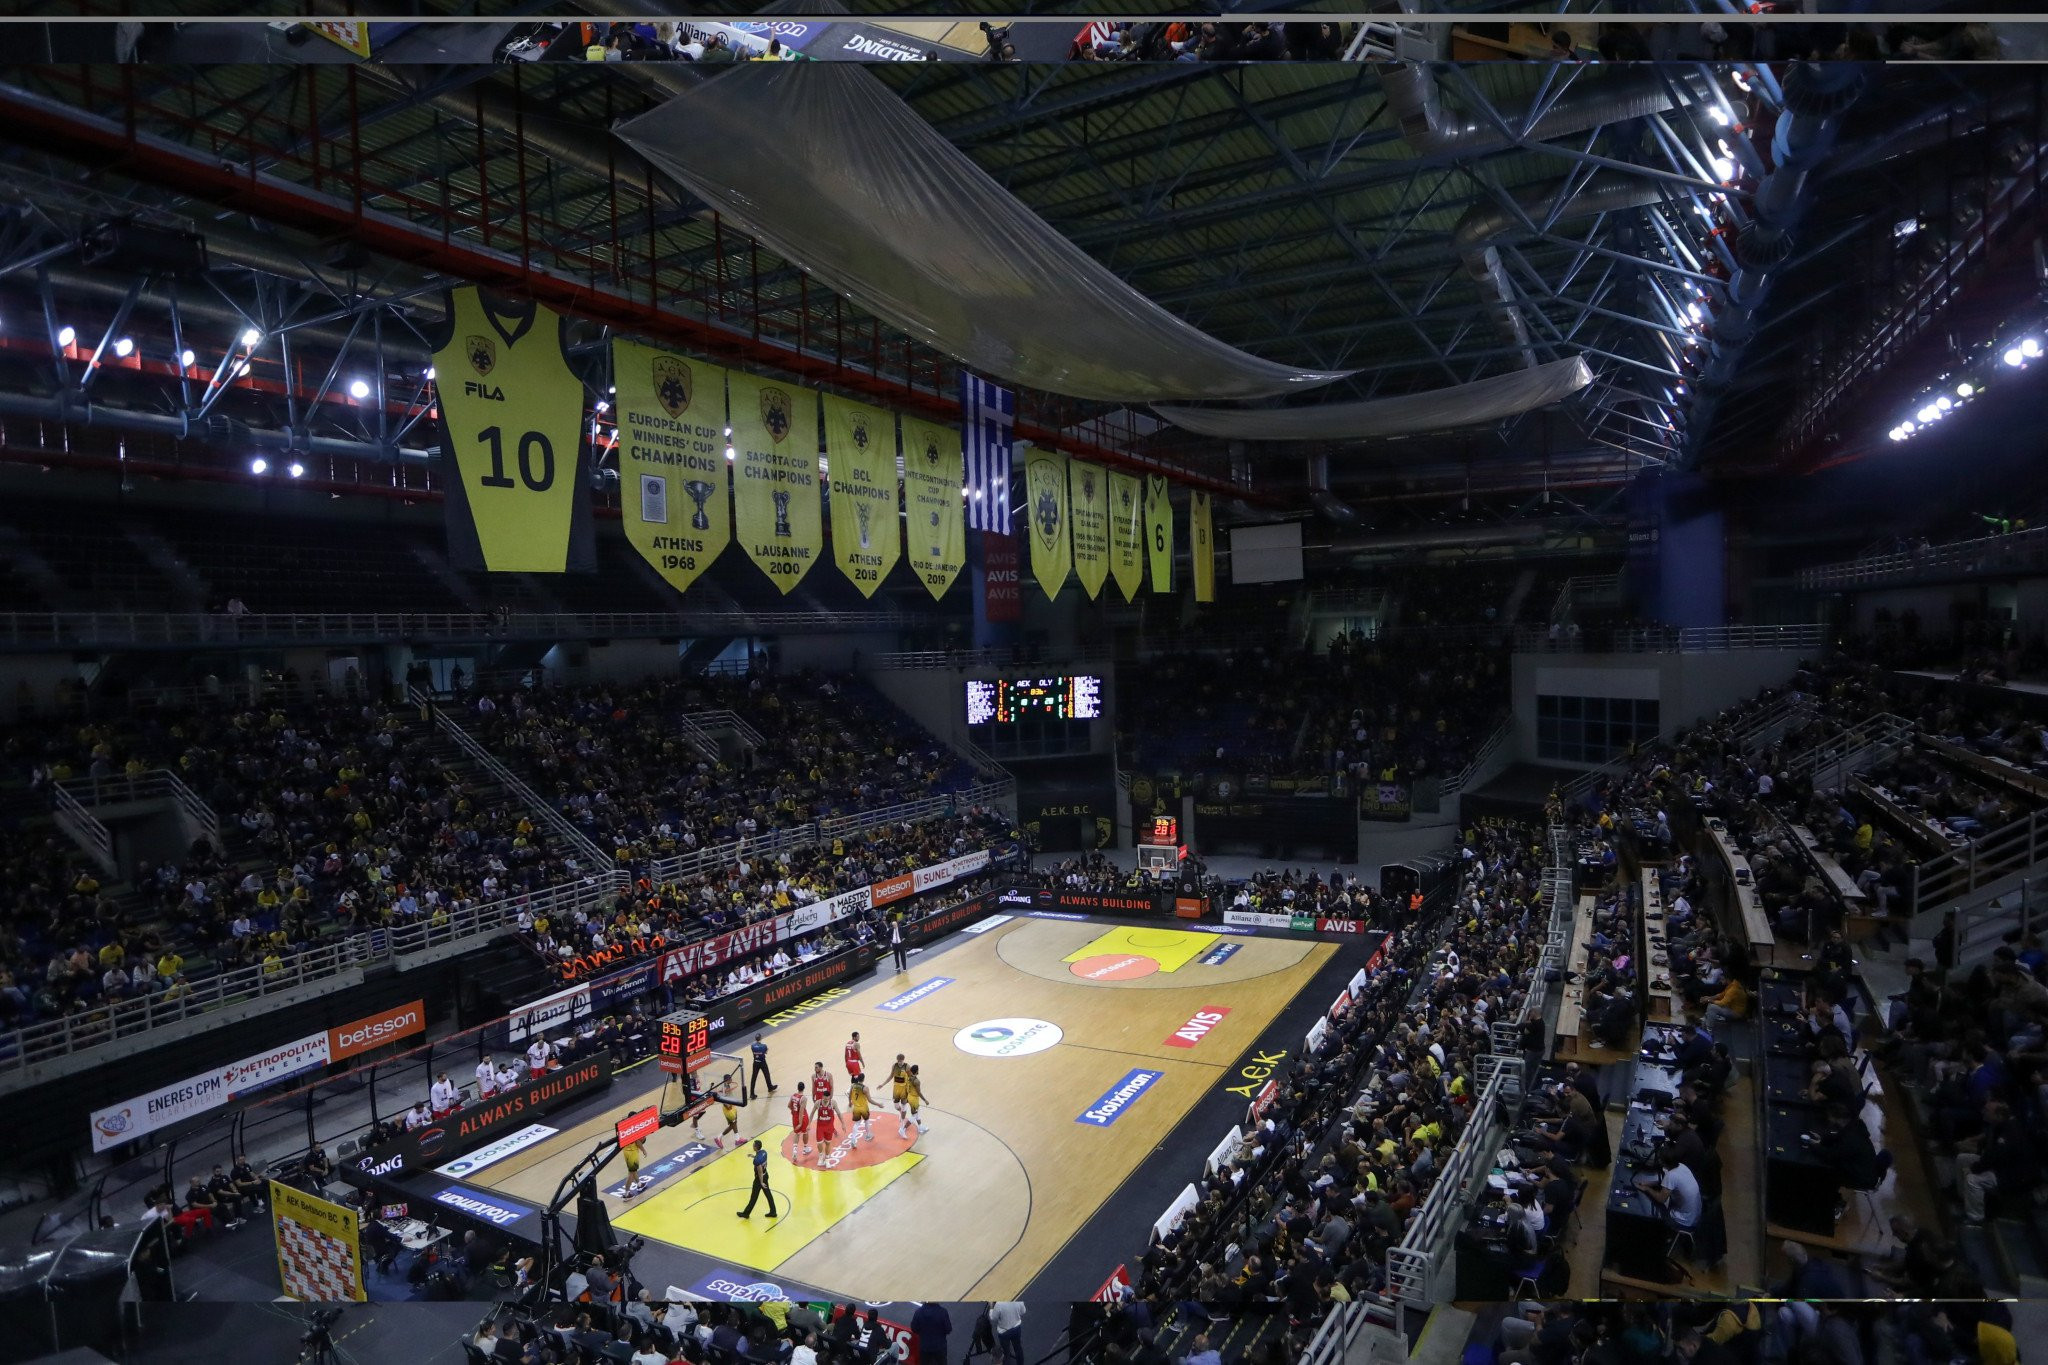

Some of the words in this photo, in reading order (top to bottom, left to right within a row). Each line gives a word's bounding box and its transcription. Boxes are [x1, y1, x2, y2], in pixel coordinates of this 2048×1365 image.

[465, 381, 505, 402] FILA
[628, 411, 692, 437] EUROPEAN
[695, 428, 717, 440] CUP
[632, 428, 690, 449] WINNERS'
[692, 438, 714, 455] CUP
[477, 425, 555, 492] 10
[630, 446, 716, 473] CHAMPIONS
[746, 451, 790, 469] SAPORTA
[791, 458, 809, 469] CUP
[744, 467, 812, 487] CHAMPIONS
[853, 469, 872, 483] BCL
[833, 481, 890, 501] CHAMPIONS
[928, 486, 940, 495] CUP
[917, 494, 951, 508] CHAMPIONS
[652, 535, 704, 553] ATHENS
[1156, 524, 1164, 552] 6
[754, 544, 810, 559] LAUSANNE
[849, 554, 882, 567] ATHENS
[661, 556, 696, 572] 1968
[770, 562, 800, 575] 2000
[913, 561, 924, 570] RIO
[925, 562, 933, 570] DE
[855, 569, 877, 581] 2018
[927, 574, 946, 585] 2019
[987, 570, 1018, 582] AVIS
[987, 588, 1019, 600] AVIS
[1038, 679, 1053, 687] OLY
[1041, 807, 1069, 816] A.E.K.
[1073, 805, 1091, 814] B.C.
[1154, 826, 1168, 835] 28
[923, 867, 952, 884] SUNEL
[837, 889, 870, 908] MAESTRO
[876, 881, 912, 898] betsson
[999, 895, 1031, 904] SPALDING
[1060, 896, 1098, 906] ALWAYS
[1102, 899, 1151, 909] BUILDING
[923, 915, 950, 933] ALWAYS
[951, 902, 982, 922] BUILDING
[1324, 920, 1356, 933] AVIS
[662, 942, 717, 981] AVIS
[724, 922, 774, 959] AVIS
[1085, 957, 1138, 979] betsson
[765, 982, 802, 1005] ALWAYS
[805, 960, 846, 987] BUILDING
[763, 988, 851, 1028] ATHENS
[339, 1012, 416, 1048] betsson
[662, 1022, 681, 1035] 8:36
[688, 1018, 708, 1034] 8:36
[1175, 1011, 1222, 1042] AVIS
[661, 1034, 681, 1054] 28
[686, 1030, 707, 1054] 28
[996, 1022, 1048, 1055] COSMOTE
[239, 1036, 326, 1074] METROPOLITAN
[661, 1060, 681, 1069] betsson
[687, 1054, 709, 1068] betsson
[240, 1048, 327, 1083] GENERAL
[147, 1085, 194, 1114] ENERES
[196, 1076, 221, 1096] CPM
[460, 1097, 524, 1136] ALWAYS
[530, 1065, 599, 1105] BUILDING
[1086, 1072, 1151, 1123] Stoiximan
[149, 1105, 183, 1124] SOLAR
[619, 1116, 656, 1138] betsson
[474, 1127, 547, 1161] COSMOTE
[672, 1143, 706, 1163] PAY
[287, 1195, 301, 1208] AEK
[328, 1212, 338, 1223] BC
[437, 1192, 521, 1223] Stoiximan
